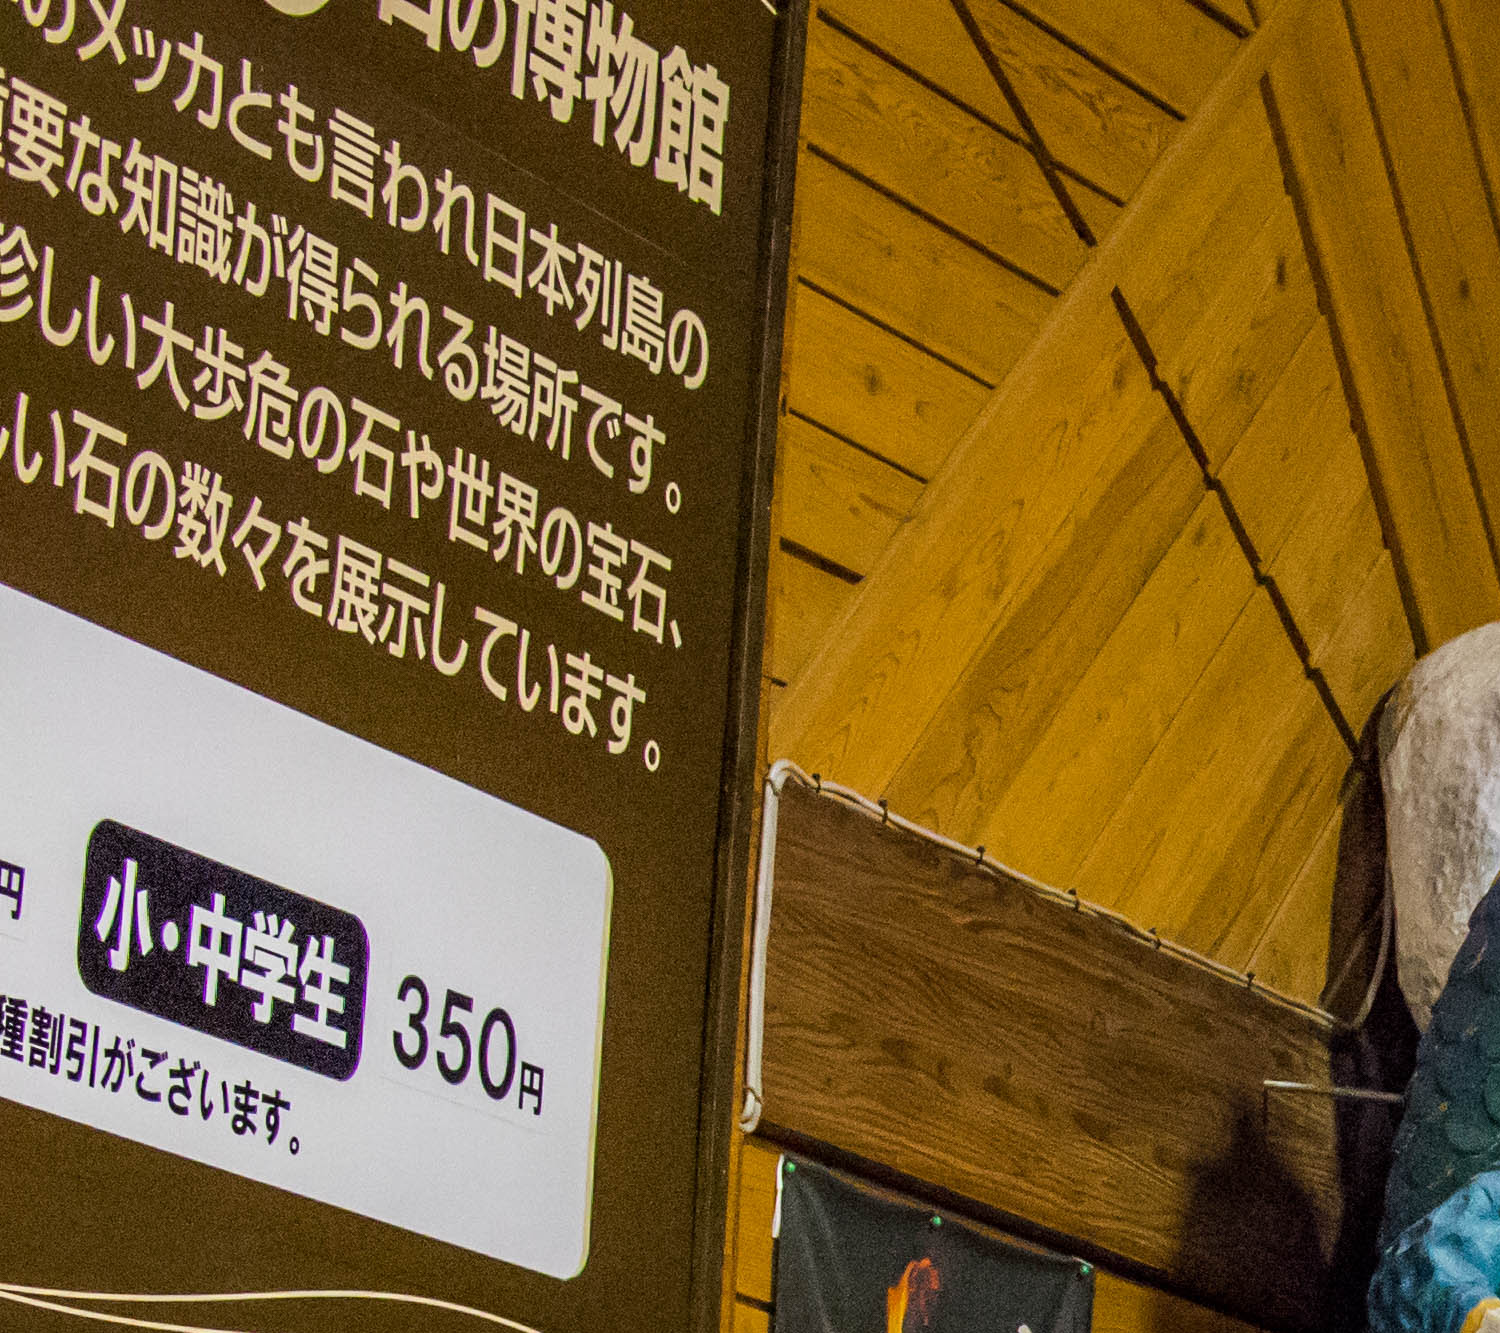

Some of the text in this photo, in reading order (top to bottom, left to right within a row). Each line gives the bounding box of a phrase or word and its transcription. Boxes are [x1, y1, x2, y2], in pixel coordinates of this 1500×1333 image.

[0, 66, 682, 514] 要な知識が得られる場所です。
[0, 392, 661, 772] い石の数々を展示しています。
[96, 858, 352, 1050] 小・中学生
[392, 974, 545, 1117] 350円
